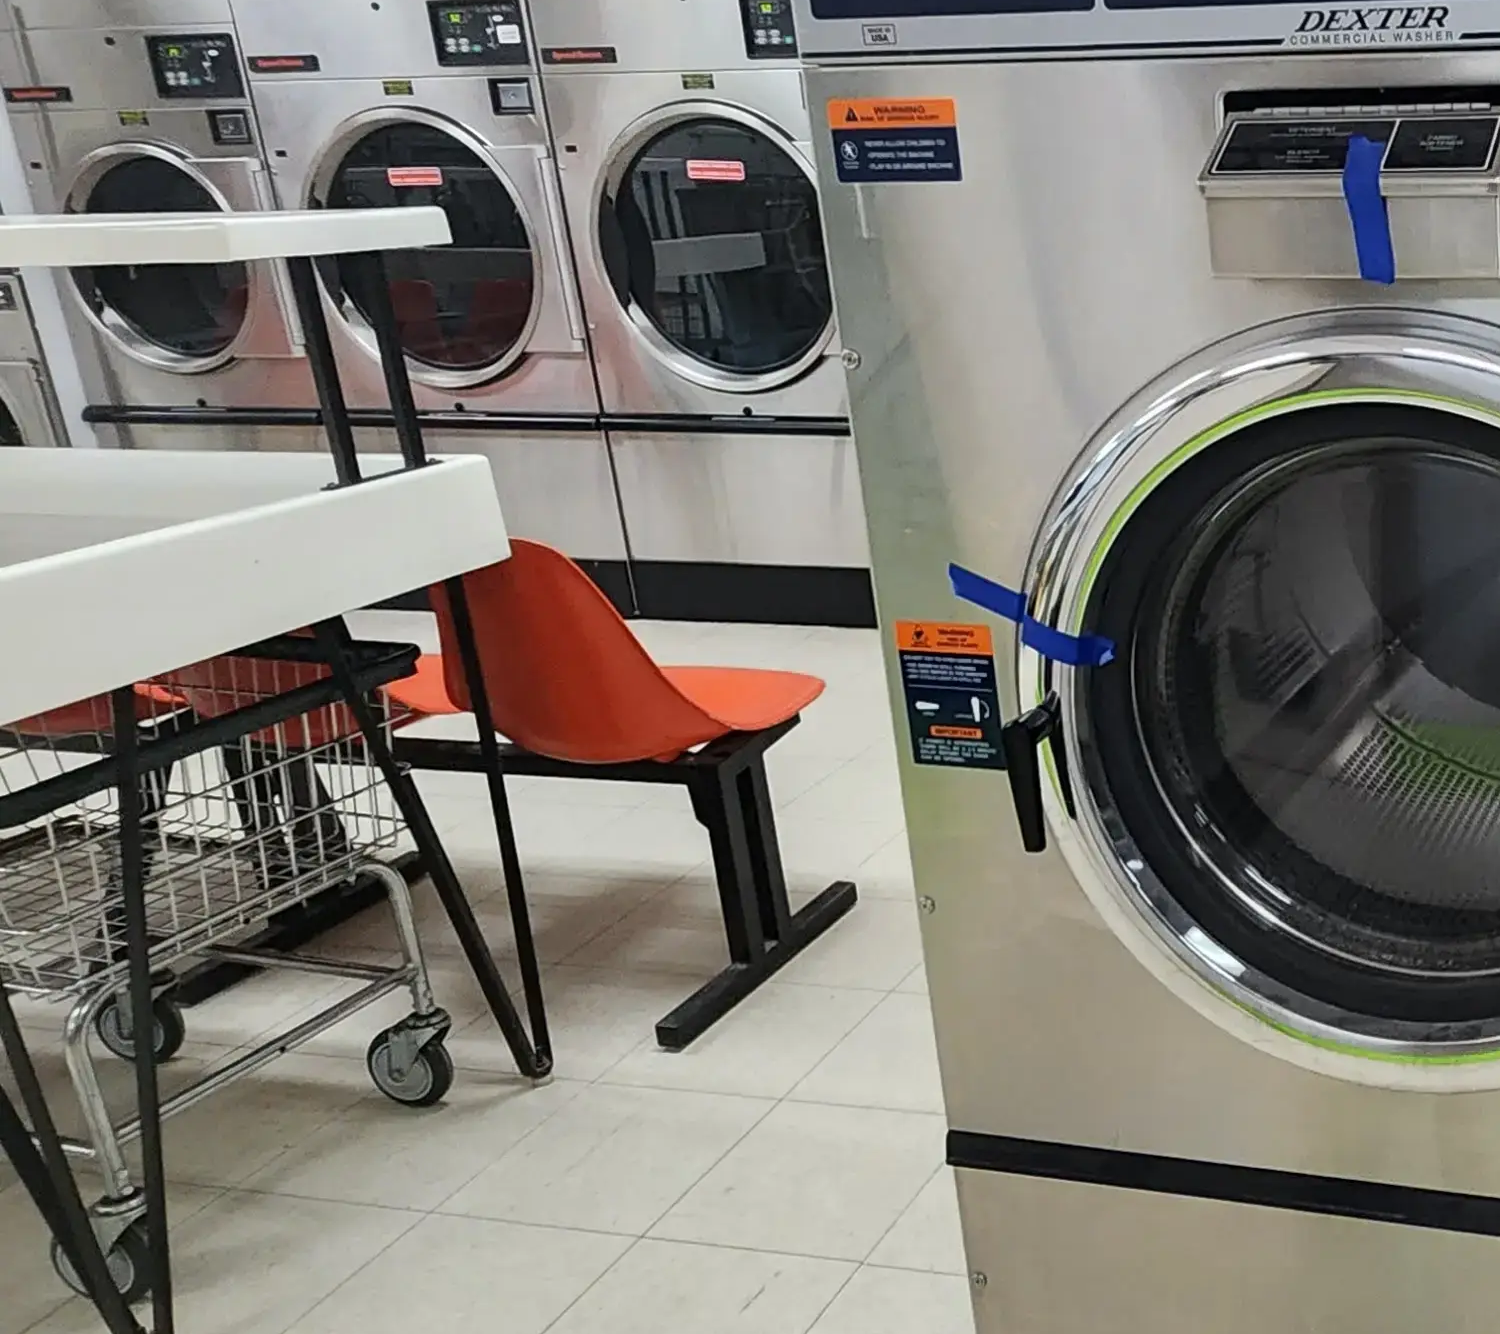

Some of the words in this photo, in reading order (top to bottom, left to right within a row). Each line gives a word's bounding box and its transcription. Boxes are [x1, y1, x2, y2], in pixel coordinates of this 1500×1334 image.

[1294, 6, 1449, 33] DEXTER
[871, 34, 888, 42] USA
[1290, 33, 1386, 46] COMMERCIAL
[1393, 30, 1453, 43] WASHER
[874, 105, 925, 114] WARNING
